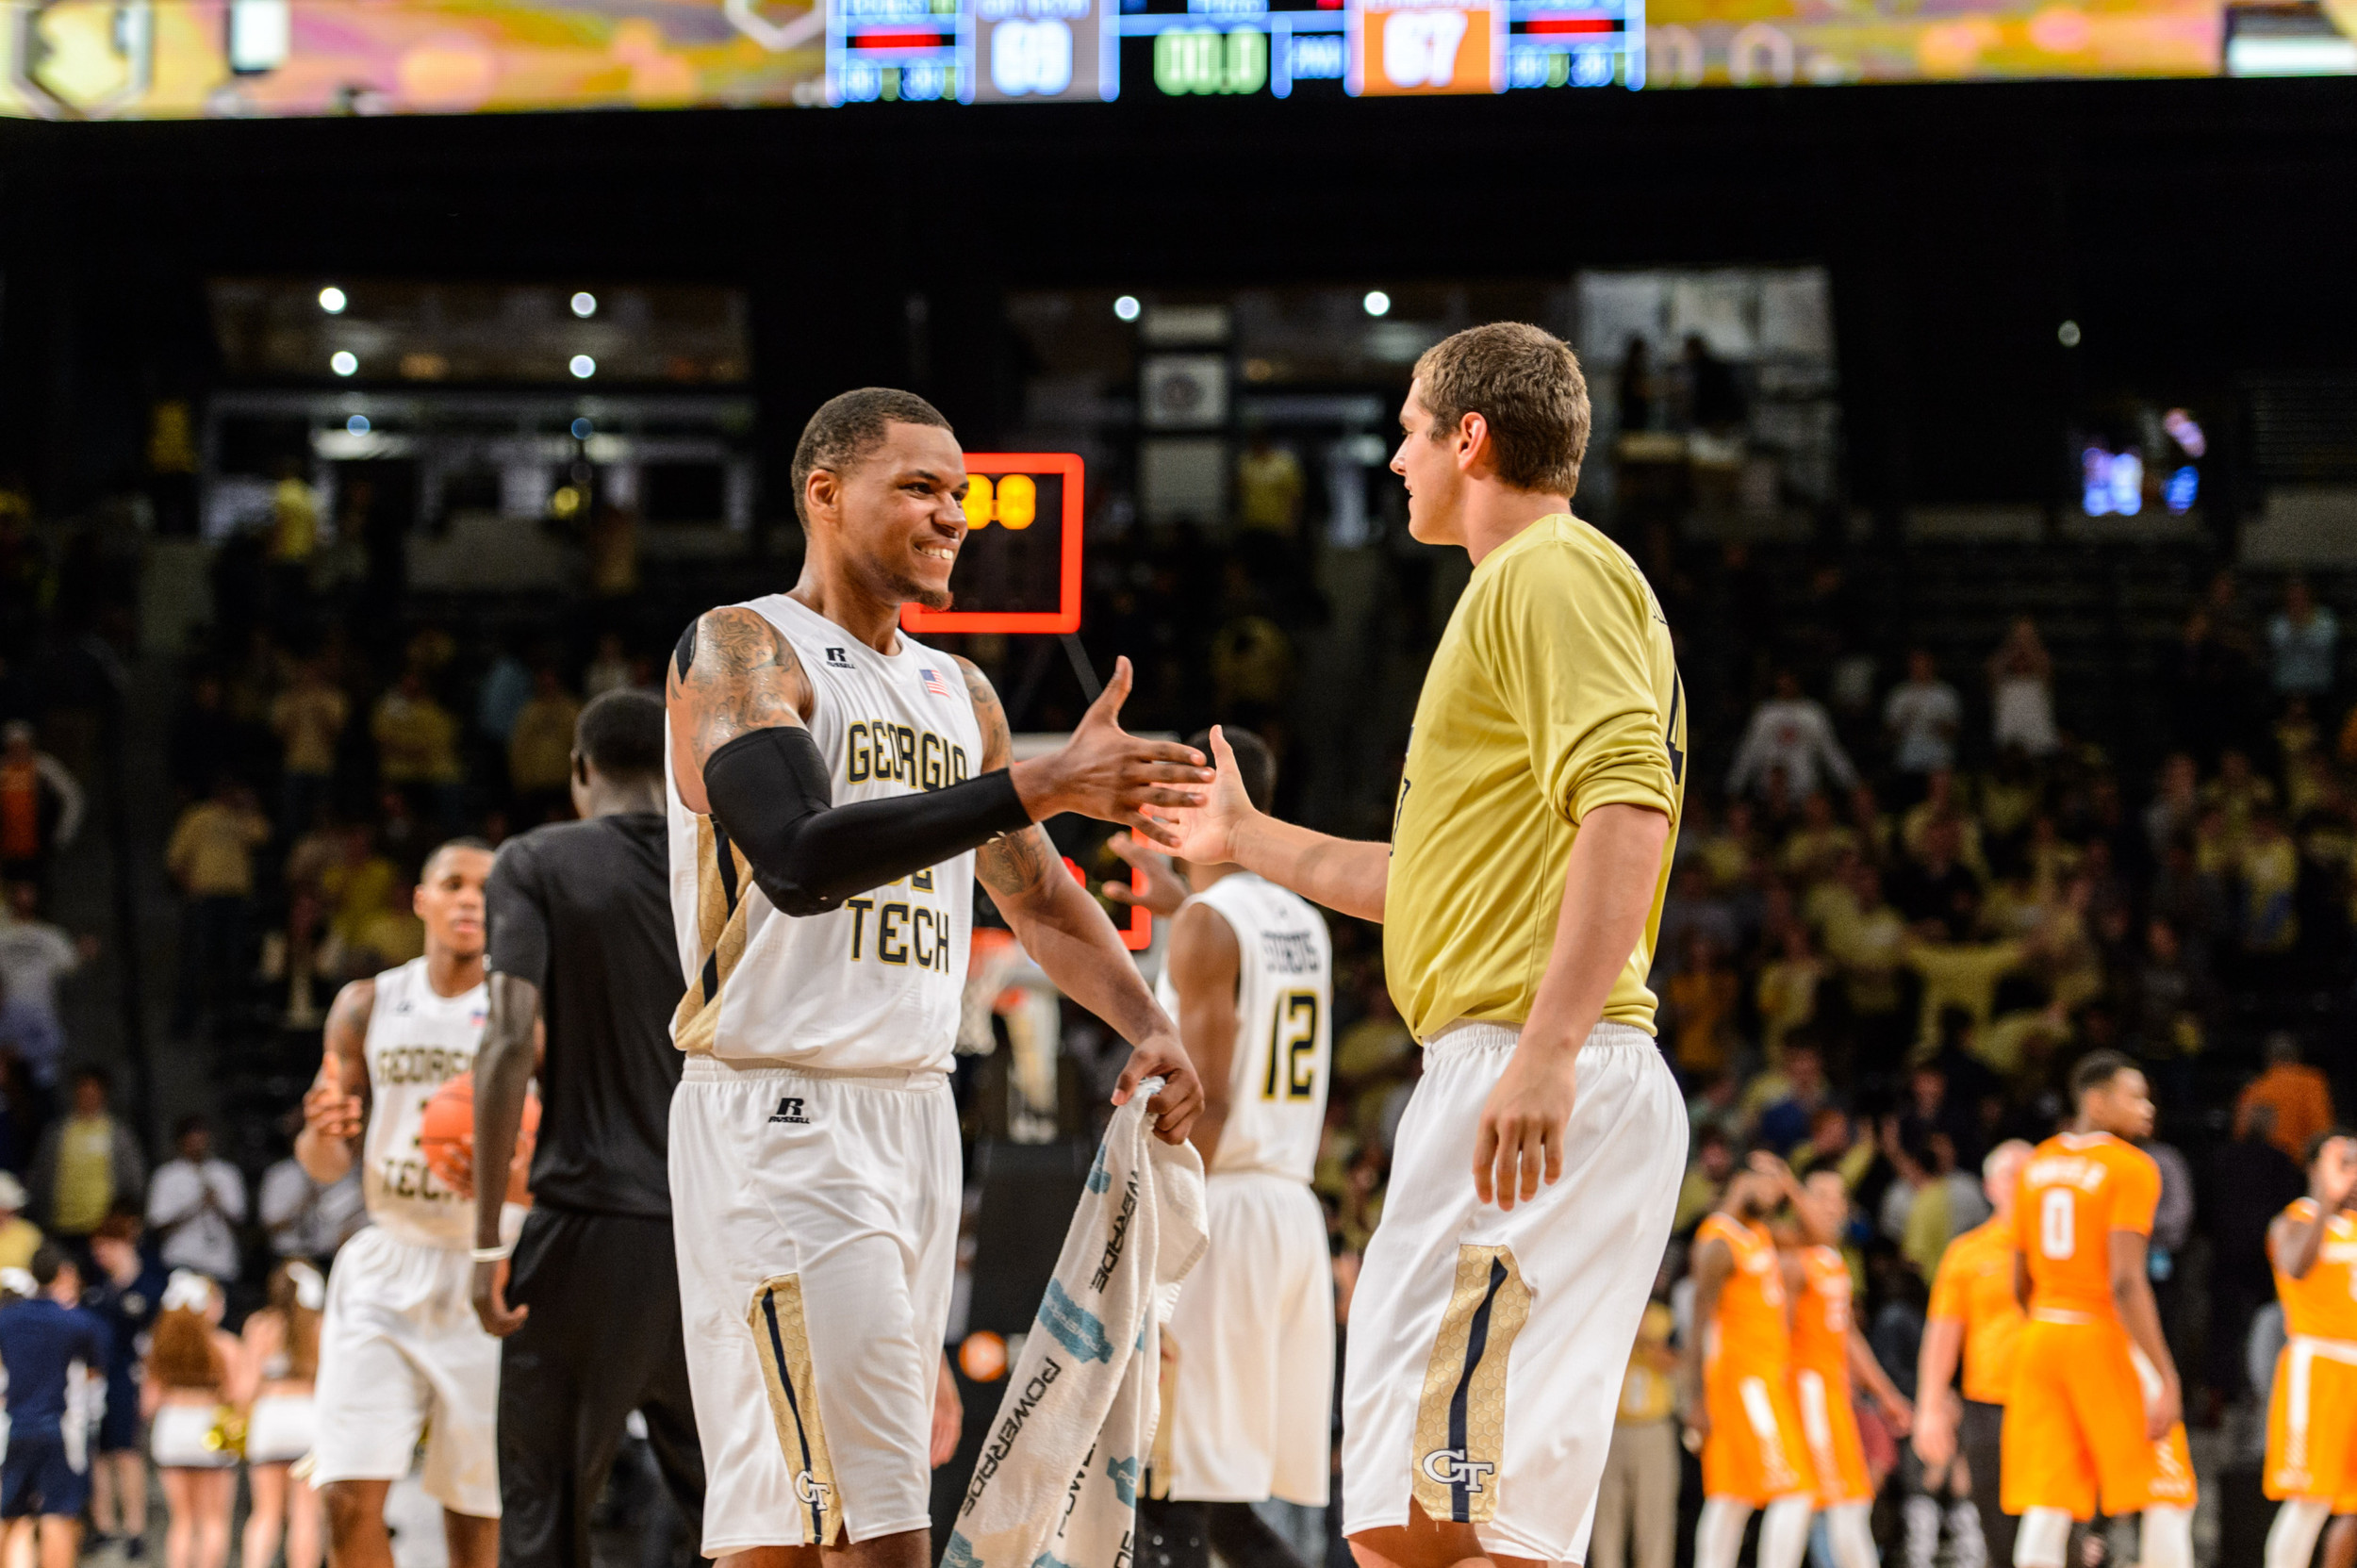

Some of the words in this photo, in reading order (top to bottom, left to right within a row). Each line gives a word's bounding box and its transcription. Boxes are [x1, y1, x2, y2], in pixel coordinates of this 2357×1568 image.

[847, 719, 968, 793] GEORGIA
[845, 896, 949, 976] TECH
[1260, 986, 1319, 1103] 12
[776, 1098, 805, 1116] R
[2040, 1186, 2075, 1260] 0
[962, 1355, 1063, 1518] POWERADE
[1422, 1448, 1495, 1494] GT
